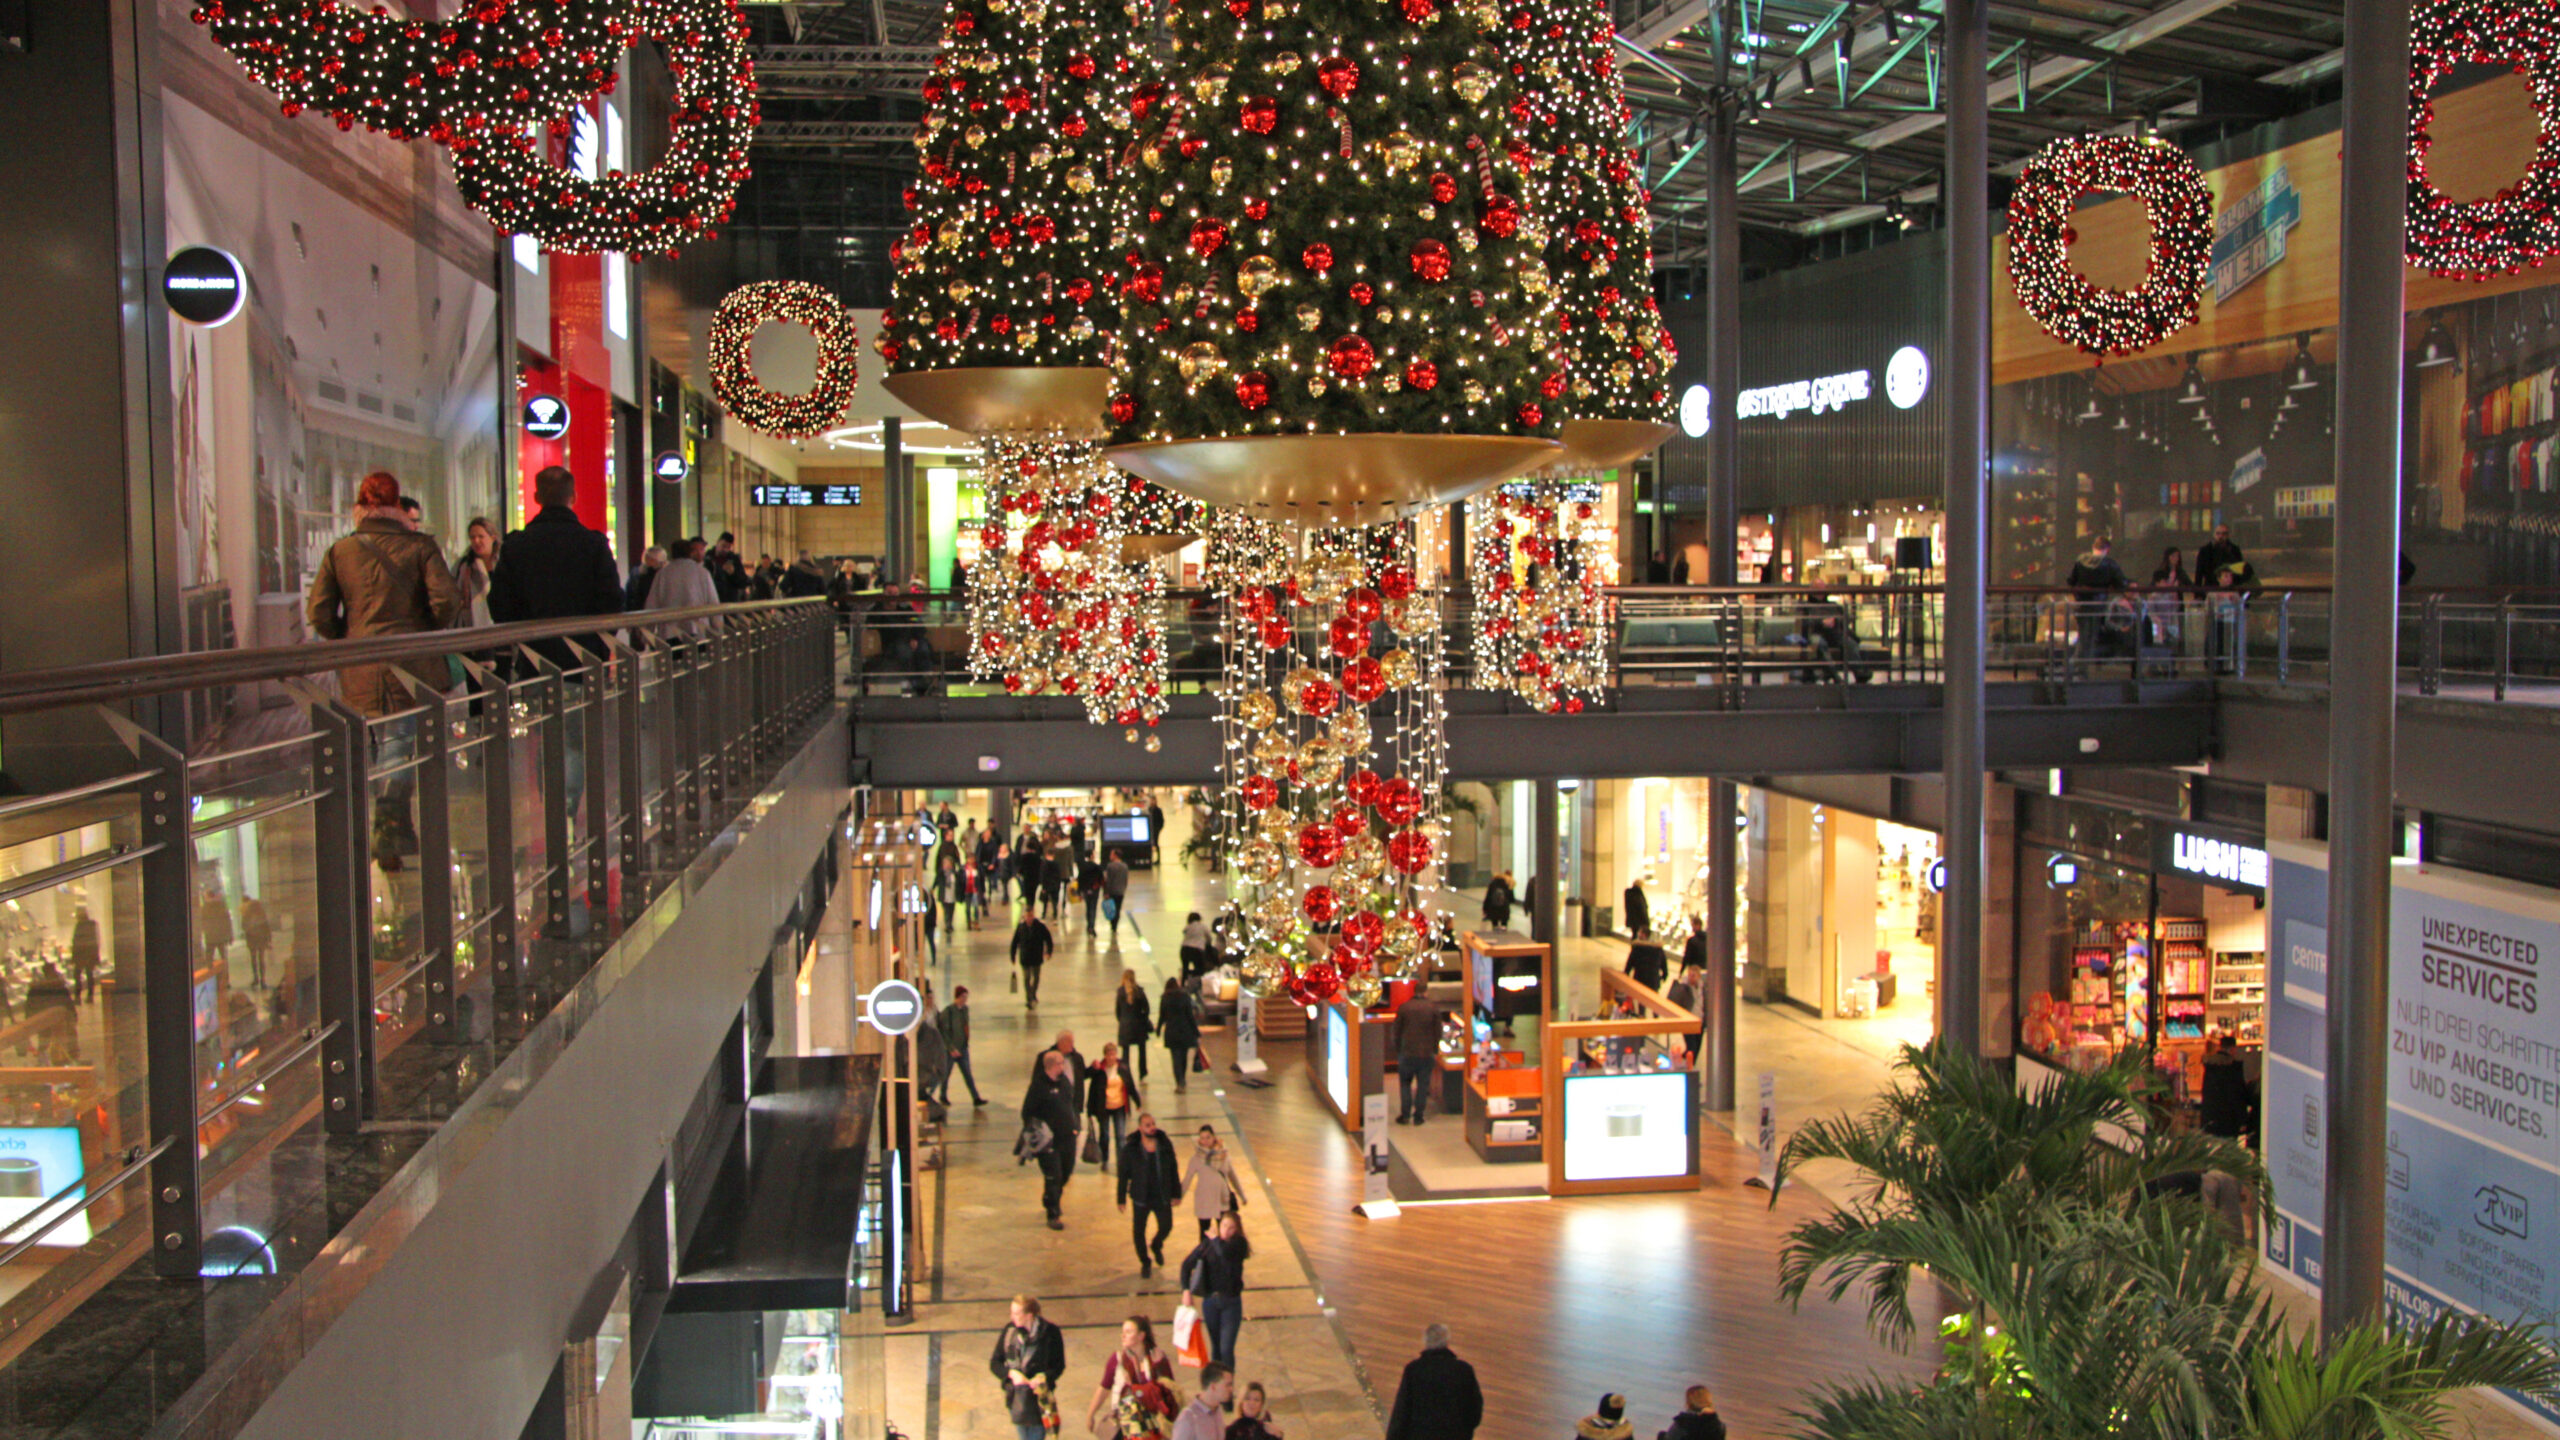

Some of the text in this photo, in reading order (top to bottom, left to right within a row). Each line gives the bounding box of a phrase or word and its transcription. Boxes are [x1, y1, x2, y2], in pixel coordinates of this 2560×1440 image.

[2217, 223, 2283, 298] WEAR
[754, 486, 764, 504] 1
[2174, 833, 2239, 881] LUSH
[2422, 916, 2538, 965] UNEXPECTED
[2422, 954, 2537, 1014] SERVICES
[2397, 998, 2430, 1029] NUR
[2435, 1010, 2472, 1043] DREI
[2393, 1029, 2415, 1055] ZU
[2420, 1037, 2446, 1064] VIP
[2409, 1067, 2547, 1138] UND SERVICES.
[2500, 1200, 2523, 1222] VIP
